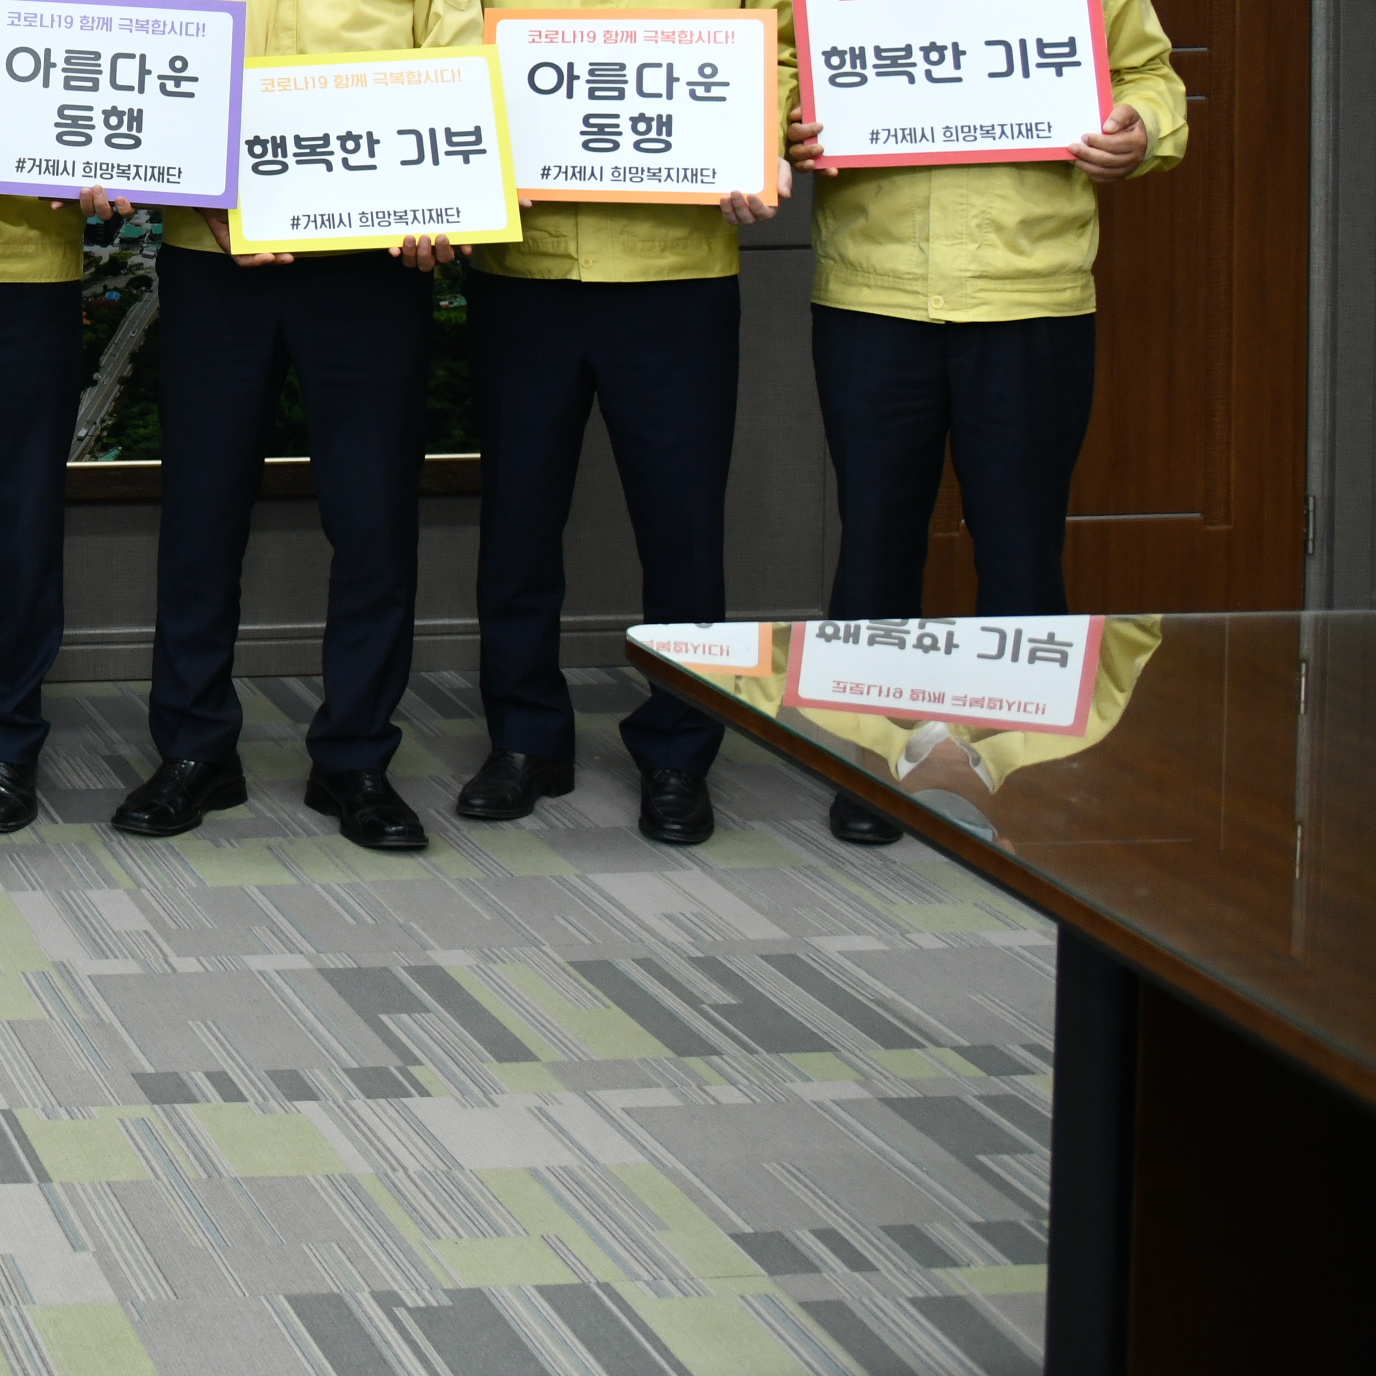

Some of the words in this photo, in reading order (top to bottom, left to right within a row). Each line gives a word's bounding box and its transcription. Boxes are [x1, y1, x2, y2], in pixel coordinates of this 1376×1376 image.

[6, 11, 74, 30] 코로나19
[79, 14, 113, 33] 함께
[118, 17, 206, 38] 극복합시다!
[527, 29, 597, 44] 코로나19
[602, 29, 637, 45] 함께
[643, 29, 735, 45] 극복합시다!
[5, 46, 200, 99] 아름다운
[821, 41, 967, 89] 행복한
[983, 36, 1082, 79] 기부
[260, 75, 329, 92] 코로나19
[333, 73, 368, 89] 함께
[372, 68, 462, 87] 극복합시다!
[527, 61, 731, 102] 아름다운
[53, 103, 144, 151] 동행
[579, 112, 673, 154] 동행
[868, 126, 935, 145] #거제시
[941, 121, 1053, 143] 희망복지재단
[244, 130, 381, 176] 행복한
[396, 125, 488, 167] 기부
[14, 157, 76, 178] #거제시
[81, 160, 183, 185] 희망복지재단
[539, 165, 604, 182] #거제시
[610, 165, 717, 185] 희망복지재단
[290, 212, 352, 231] #거제시
[358, 207, 462, 228] 희망복지재단
